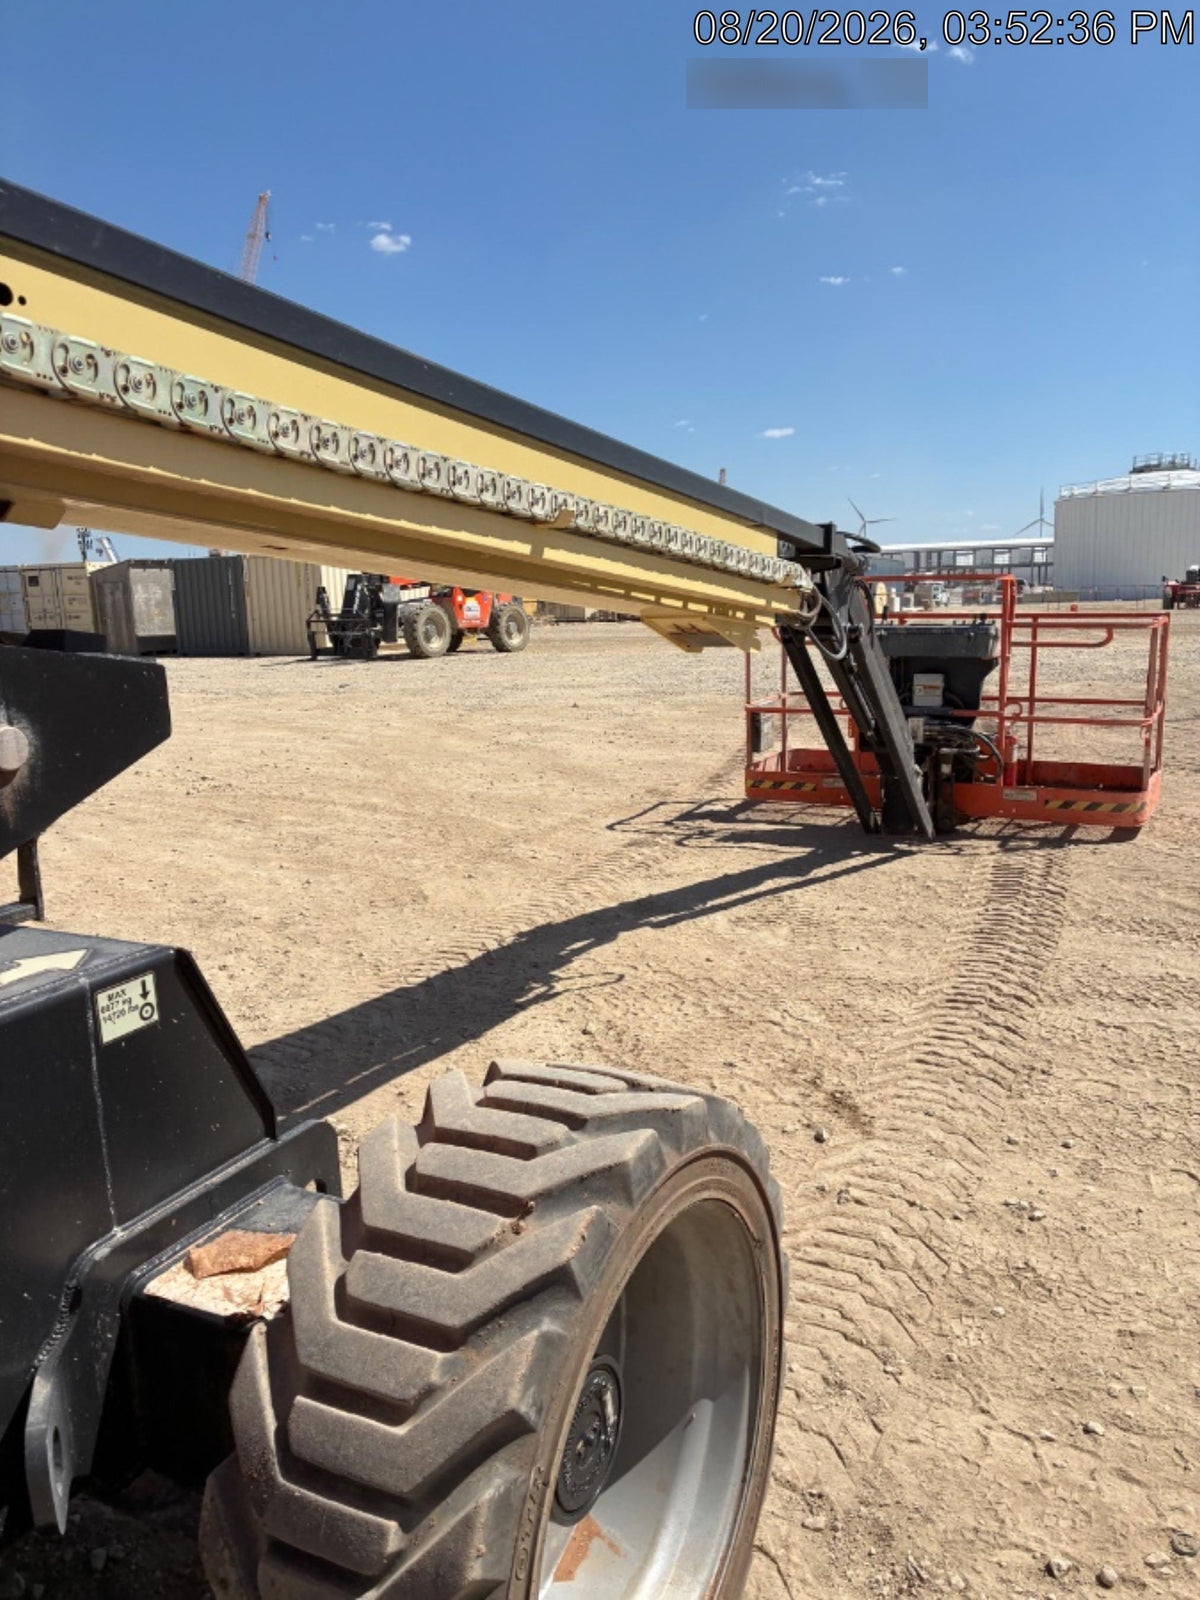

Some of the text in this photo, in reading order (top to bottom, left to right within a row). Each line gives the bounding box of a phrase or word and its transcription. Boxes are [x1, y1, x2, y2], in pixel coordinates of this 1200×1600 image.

[108, 989, 127, 1002] MAX
[122, 997, 132, 1007] kg
[128, 1004, 139, 1014] lbs
